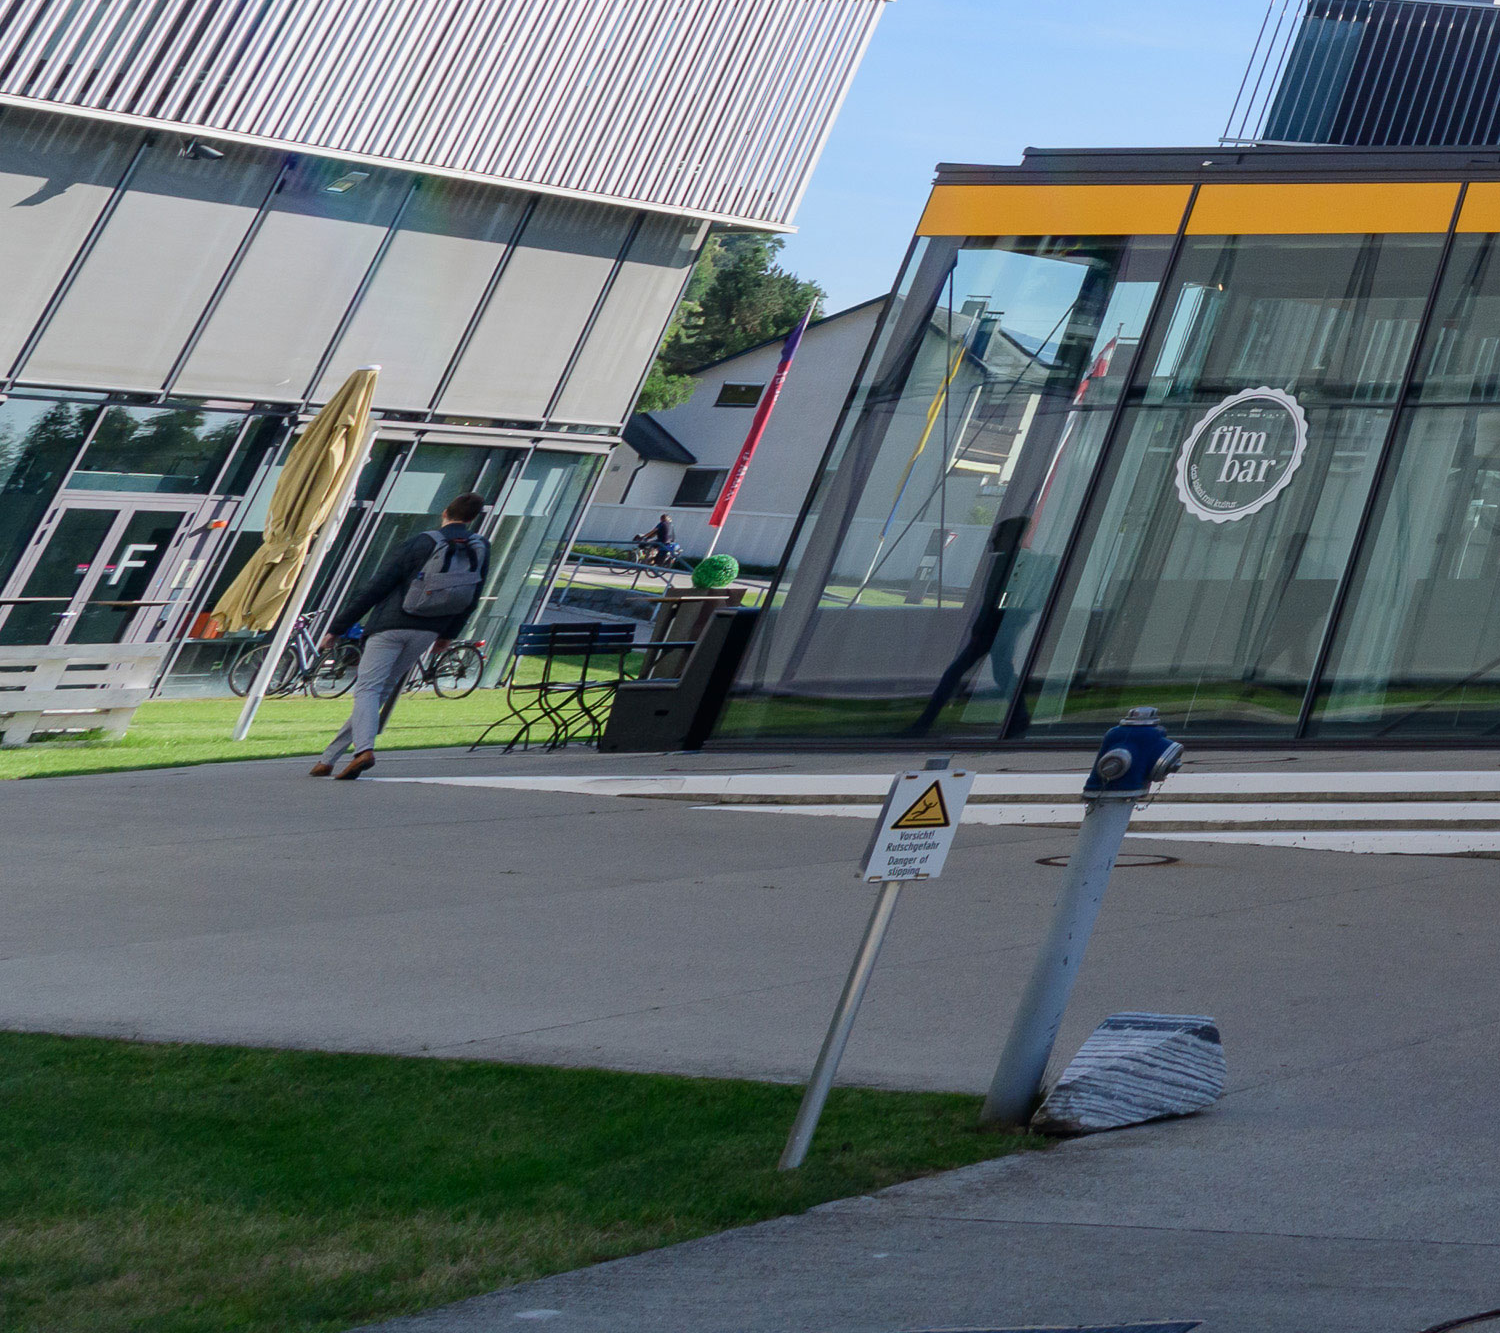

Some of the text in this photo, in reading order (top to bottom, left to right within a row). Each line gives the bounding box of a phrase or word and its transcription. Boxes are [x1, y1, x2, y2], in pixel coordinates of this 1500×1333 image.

[1205, 425, 1266, 454] film
[1216, 450, 1276, 483] bar
[108, 544, 158, 585] F
[900, 831, 935, 841] Vorsicht!
[886, 841, 940, 852] Rutschgefahr
[888, 854, 929, 866] Danger of
[888, 866, 920, 877] slipping
